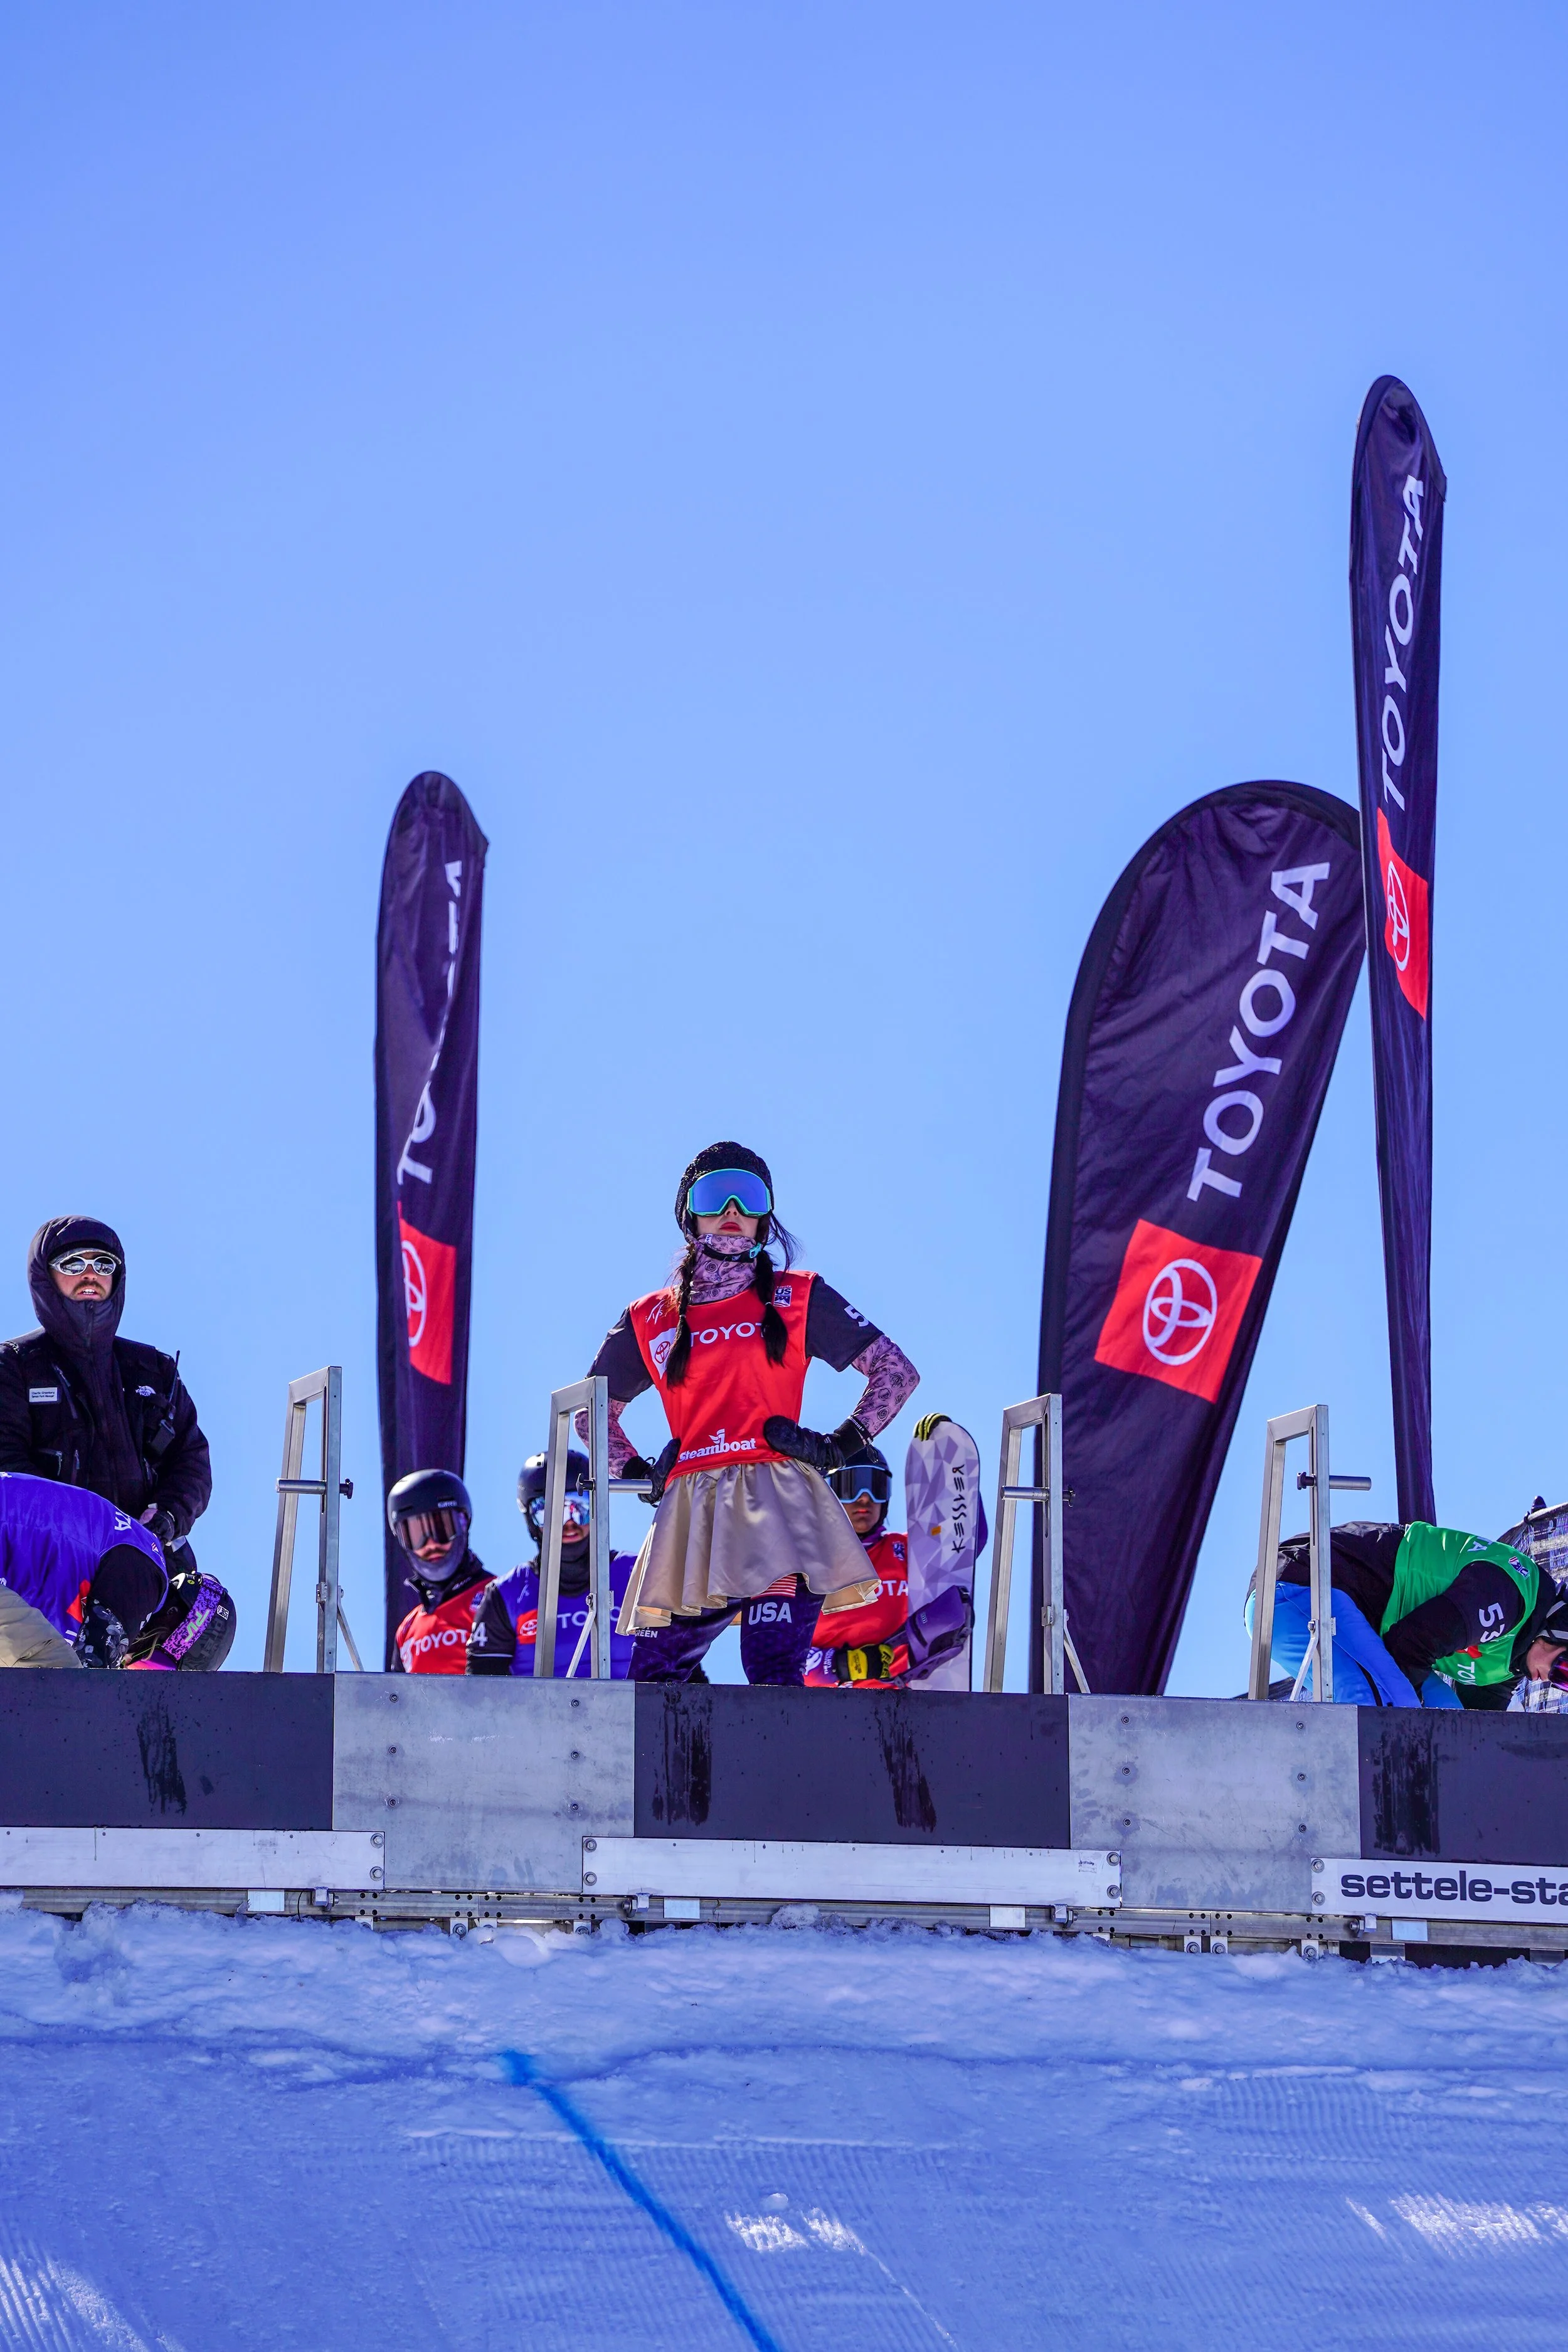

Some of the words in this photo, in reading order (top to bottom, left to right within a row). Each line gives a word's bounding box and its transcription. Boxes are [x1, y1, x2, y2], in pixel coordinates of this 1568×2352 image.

[1381, 474, 1424, 812] TOYOTA
[1187, 861, 1330, 1201] TOYOTA
[844, 1305, 869, 1327] 5
[748, 1602, 792, 1625] USA
[1478, 1602, 1505, 1643] 53
[473, 1622, 488, 1647] 4
